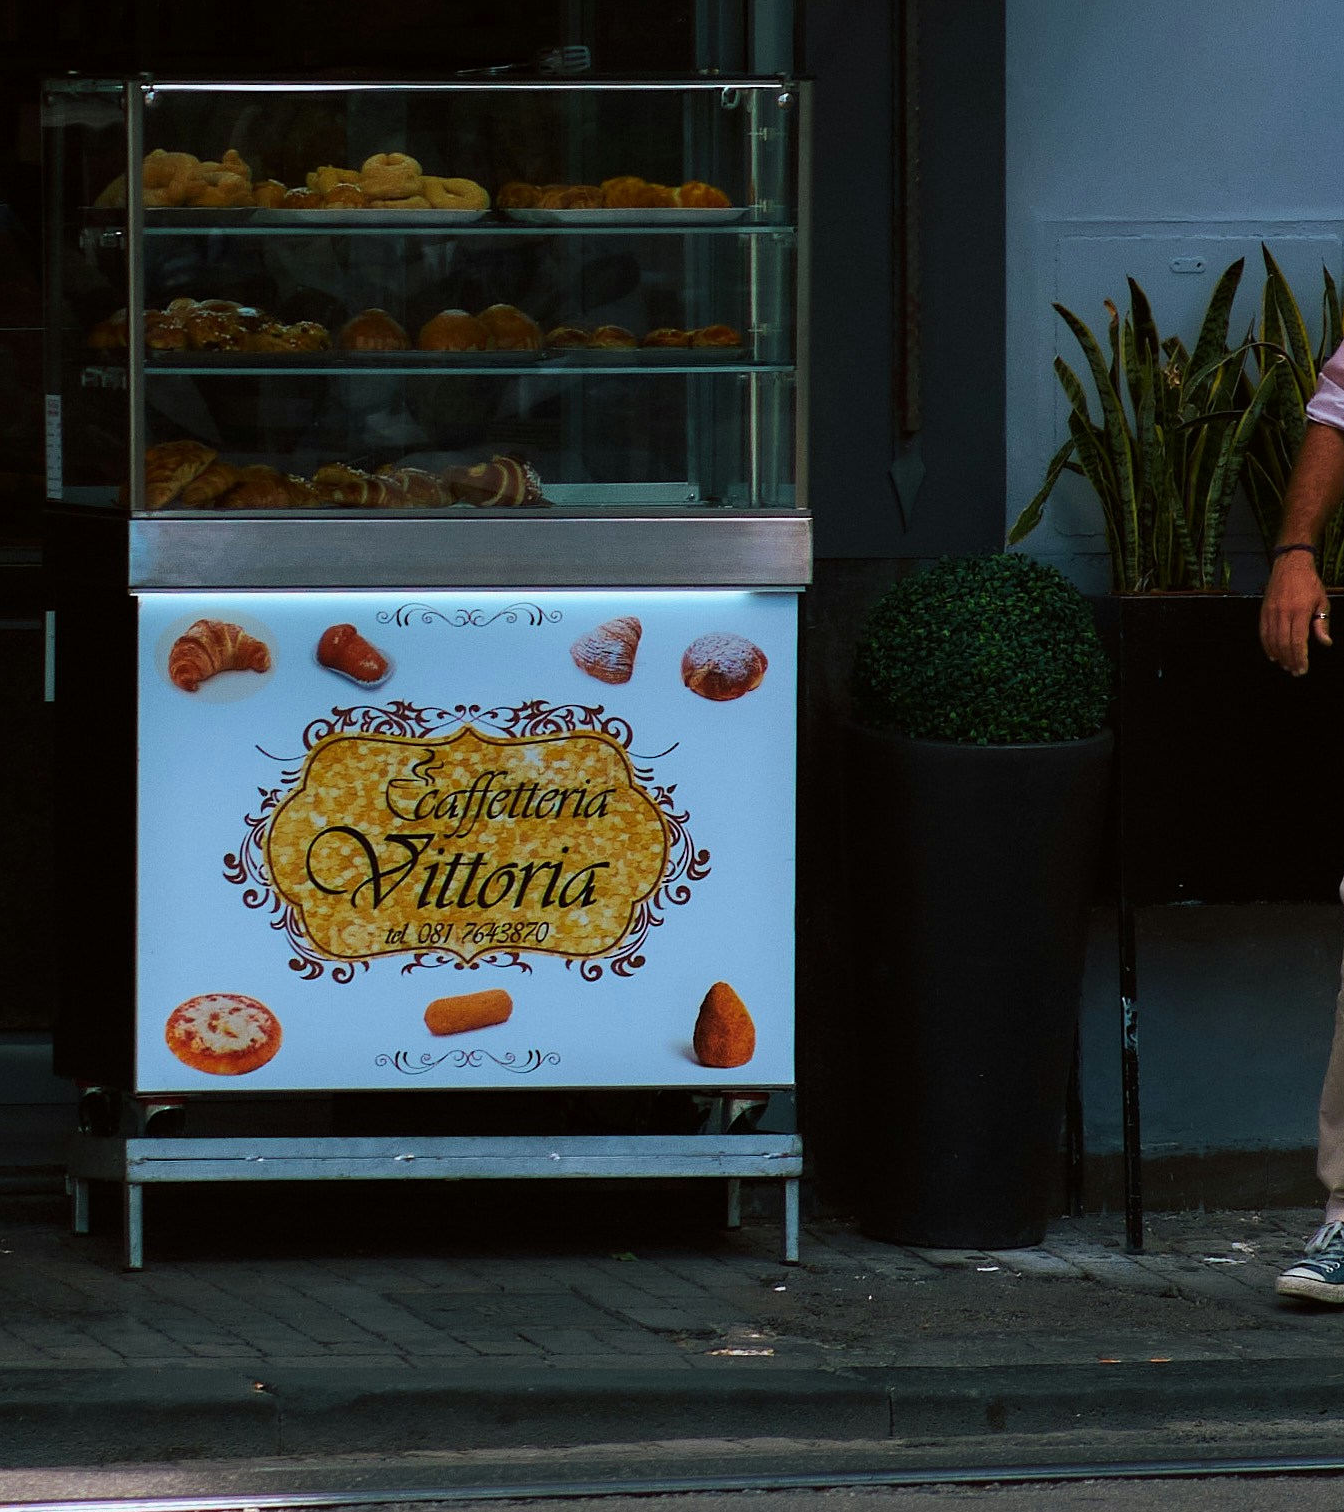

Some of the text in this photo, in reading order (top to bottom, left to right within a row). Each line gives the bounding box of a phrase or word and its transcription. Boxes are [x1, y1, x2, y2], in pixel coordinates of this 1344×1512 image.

[306, 825, 610, 910] Vittoria
[417, 922, 455, 944] 081
[461, 921, 550, 944] 7643870
